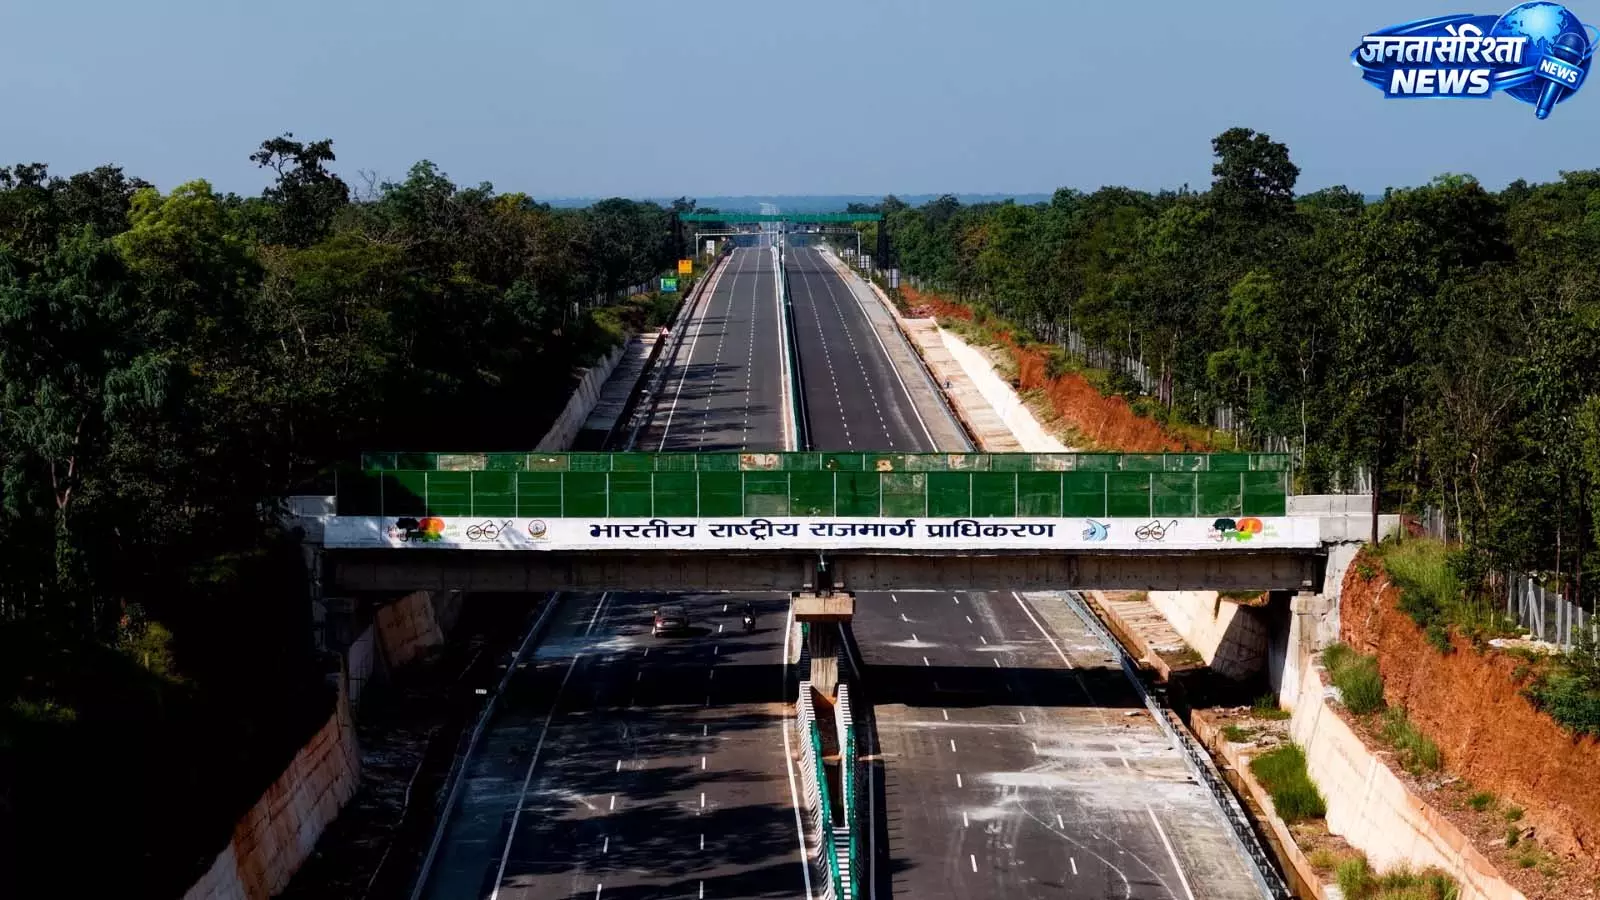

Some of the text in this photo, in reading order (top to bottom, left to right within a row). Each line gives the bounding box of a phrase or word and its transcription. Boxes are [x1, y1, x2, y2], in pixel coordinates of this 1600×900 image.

[589, 518, 1056, 541] भारतीय राष्ट्रीय राजमार्ग प्राधिकरण
